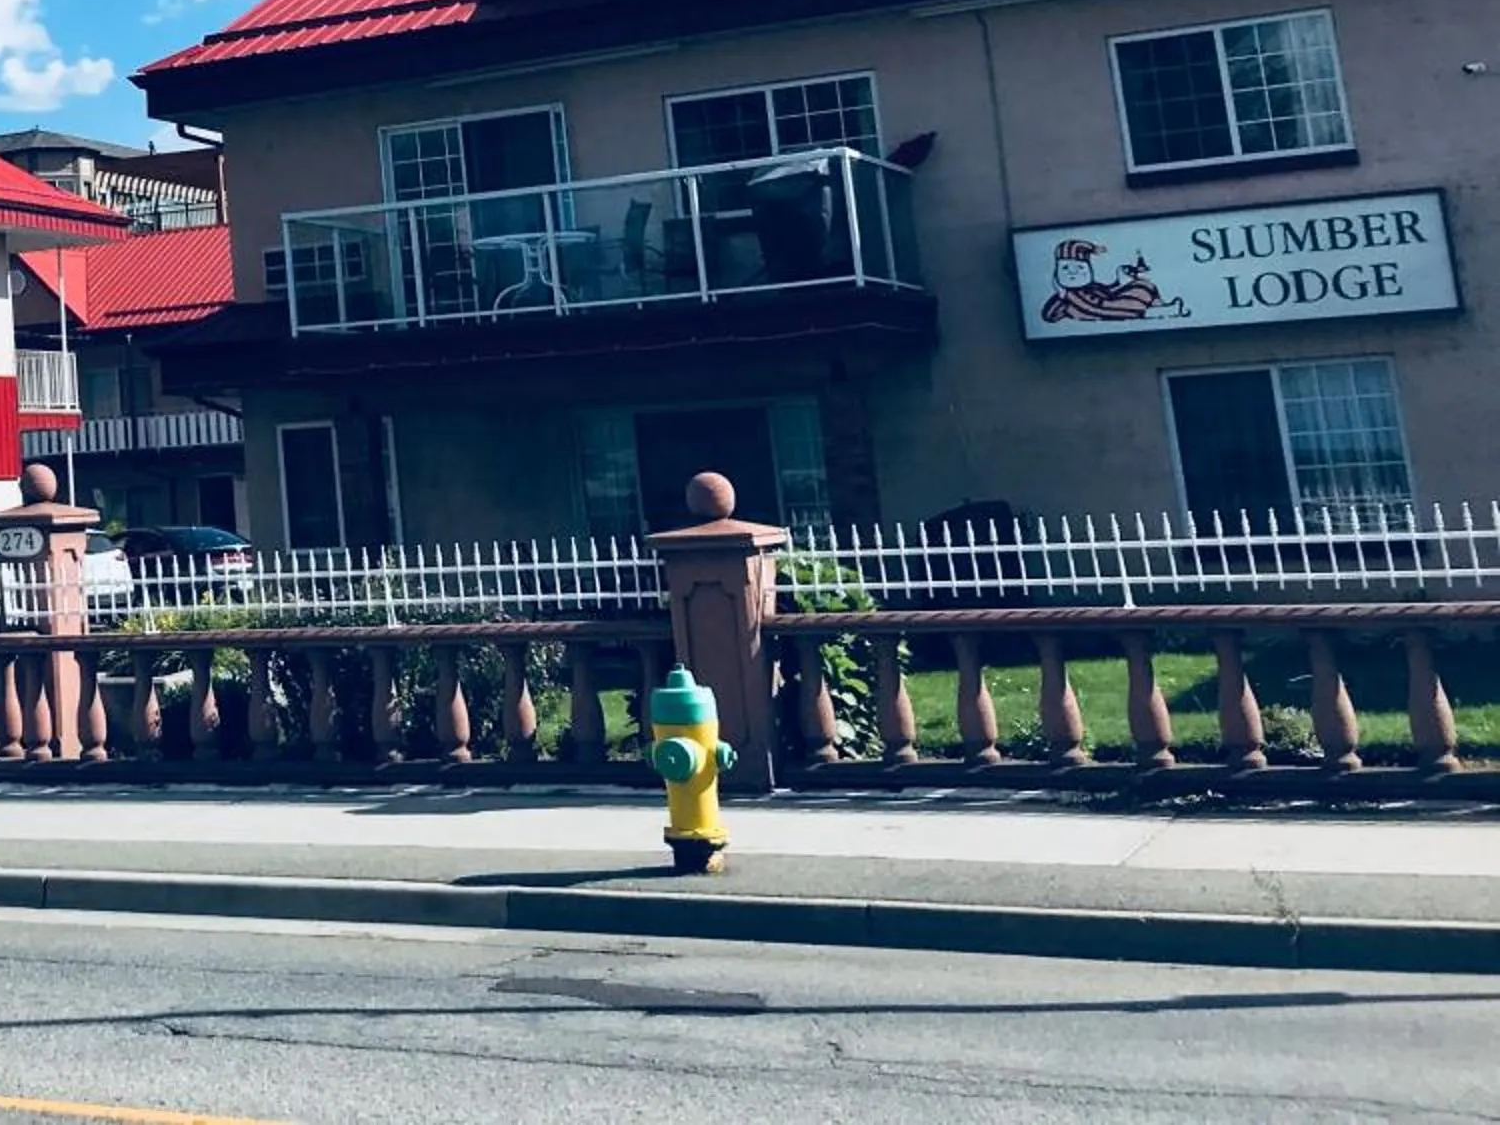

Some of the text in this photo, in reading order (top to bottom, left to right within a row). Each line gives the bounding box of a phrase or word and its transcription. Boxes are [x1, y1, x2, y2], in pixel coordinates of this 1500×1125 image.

[1191, 210, 1427, 263] SLUMBER
[1224, 263, 1403, 309] LODGE
[1, 531, 35, 552] 274
